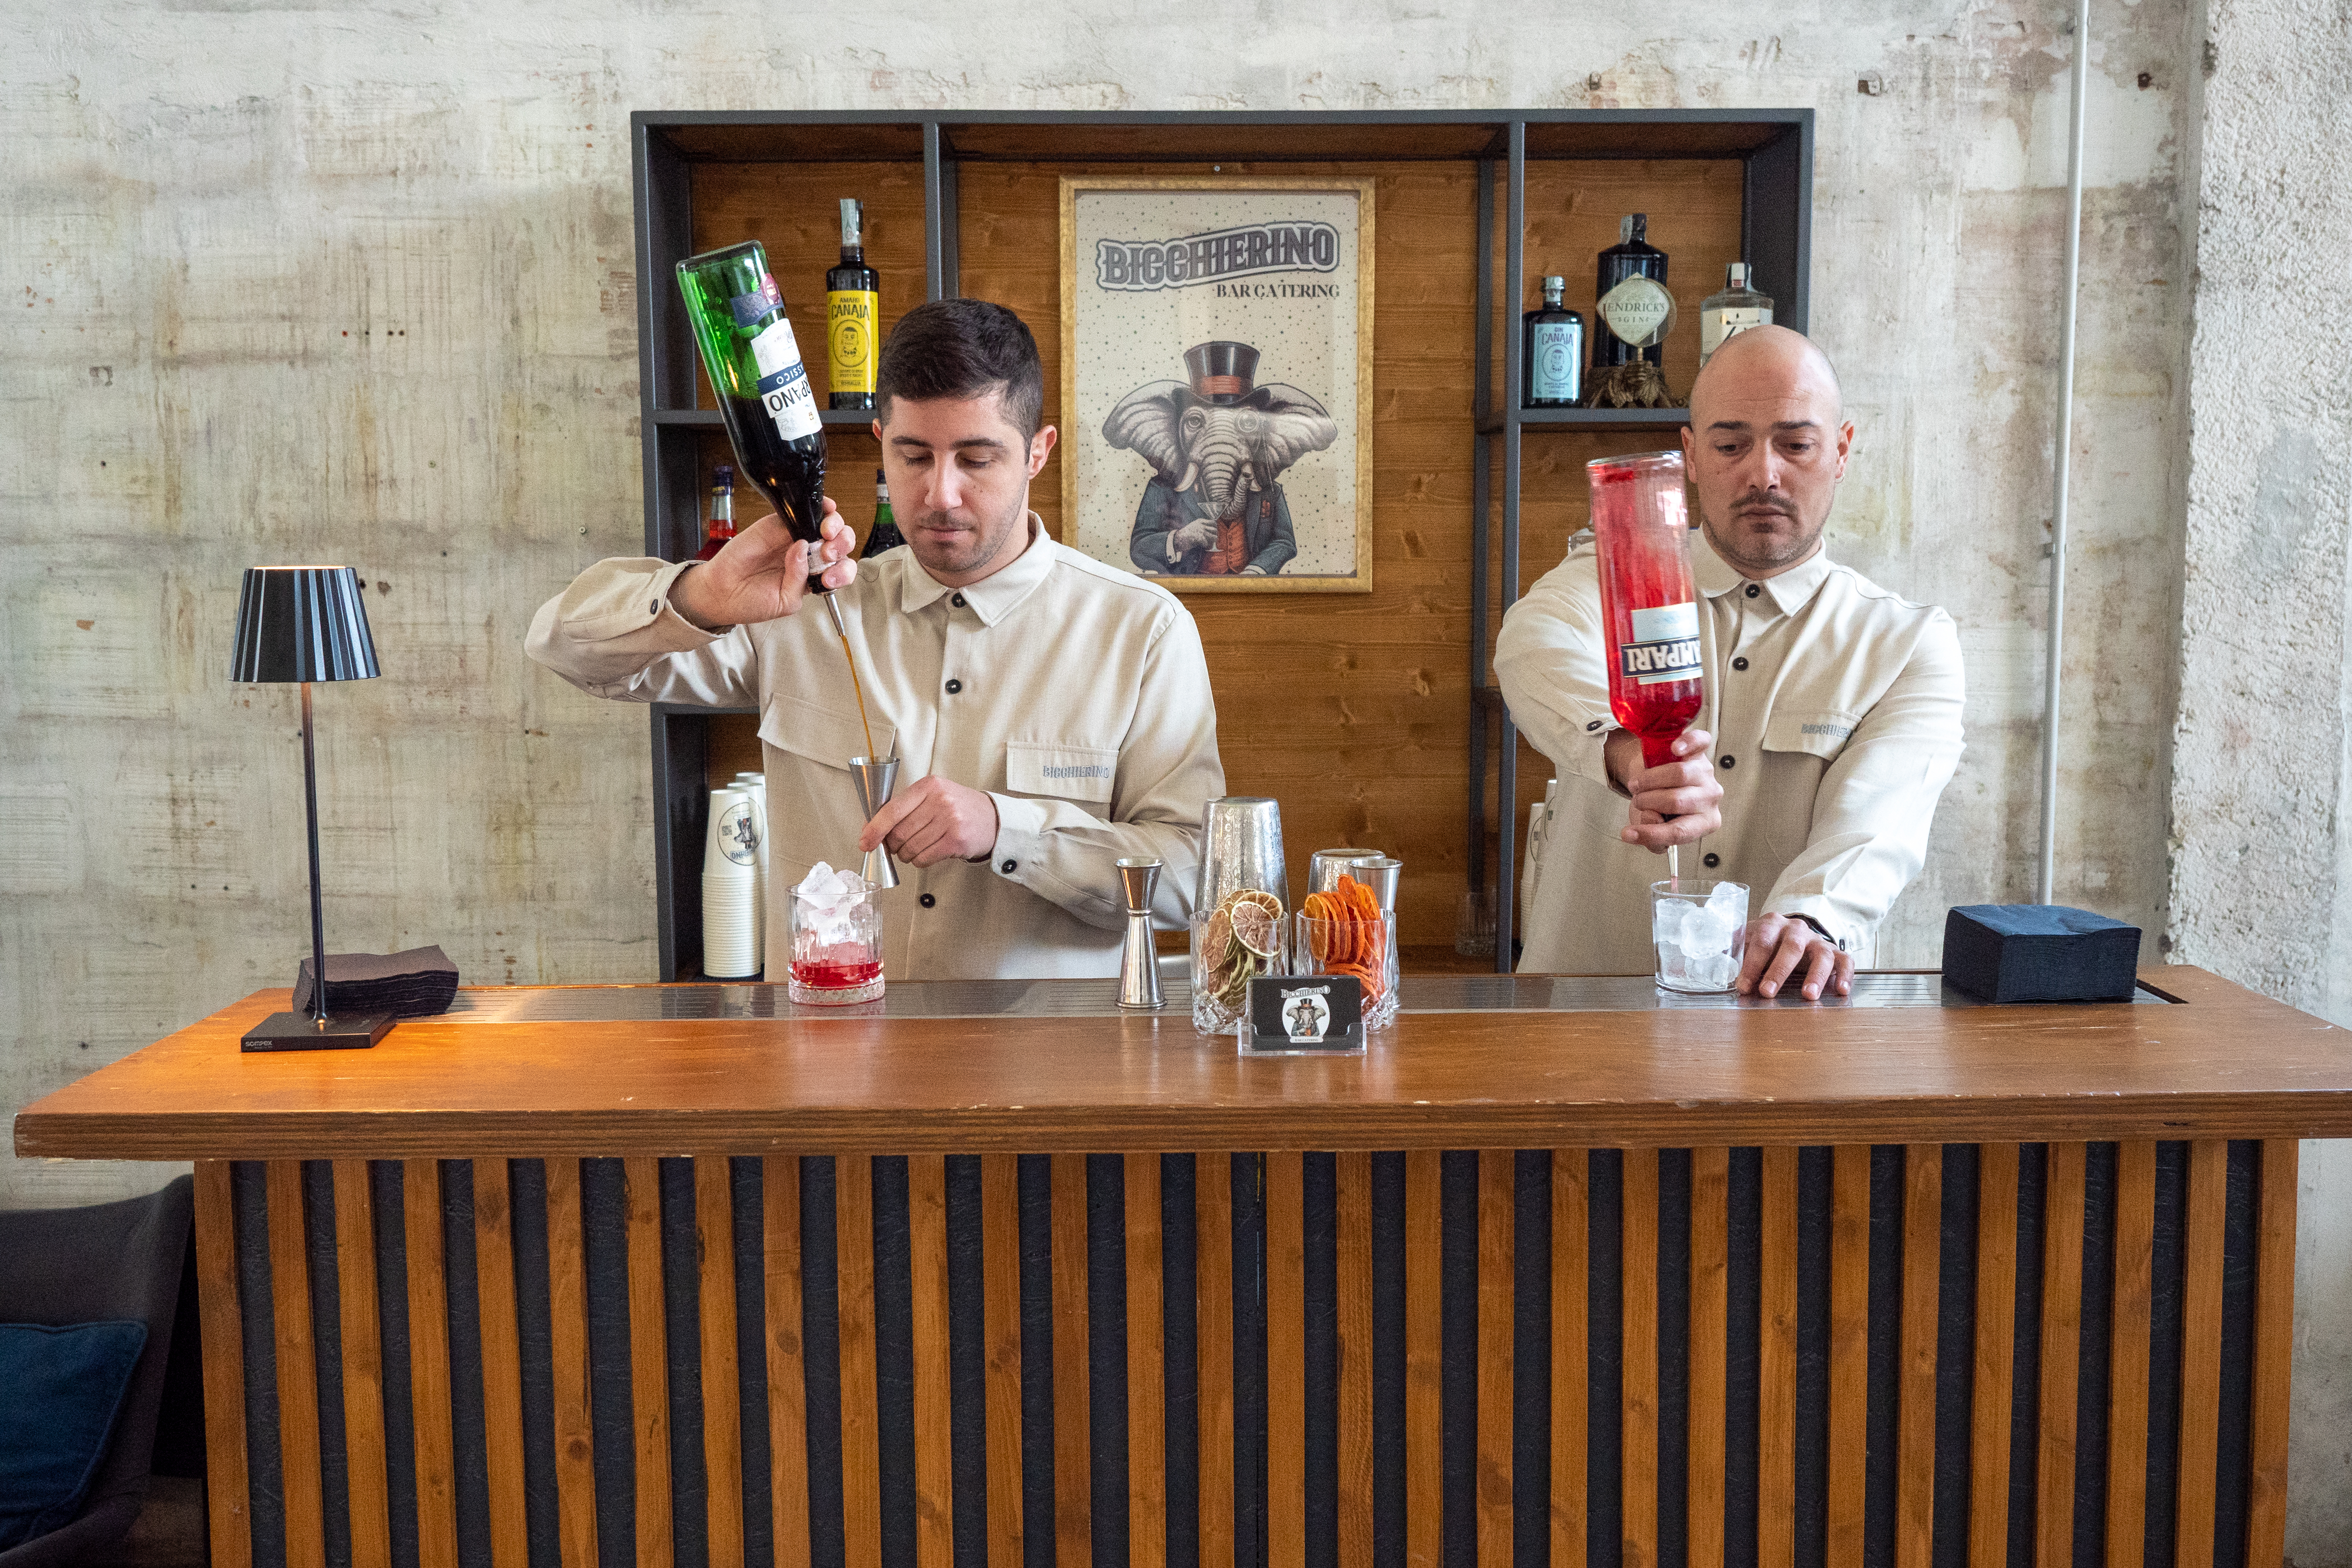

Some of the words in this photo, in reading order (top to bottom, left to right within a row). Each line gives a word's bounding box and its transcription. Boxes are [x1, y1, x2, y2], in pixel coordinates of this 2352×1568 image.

[1217, 284, 1250, 298] BAR
[1254, 283, 1340, 298] CATERING
[1281, 985, 1330, 998] BICCHIERINO
